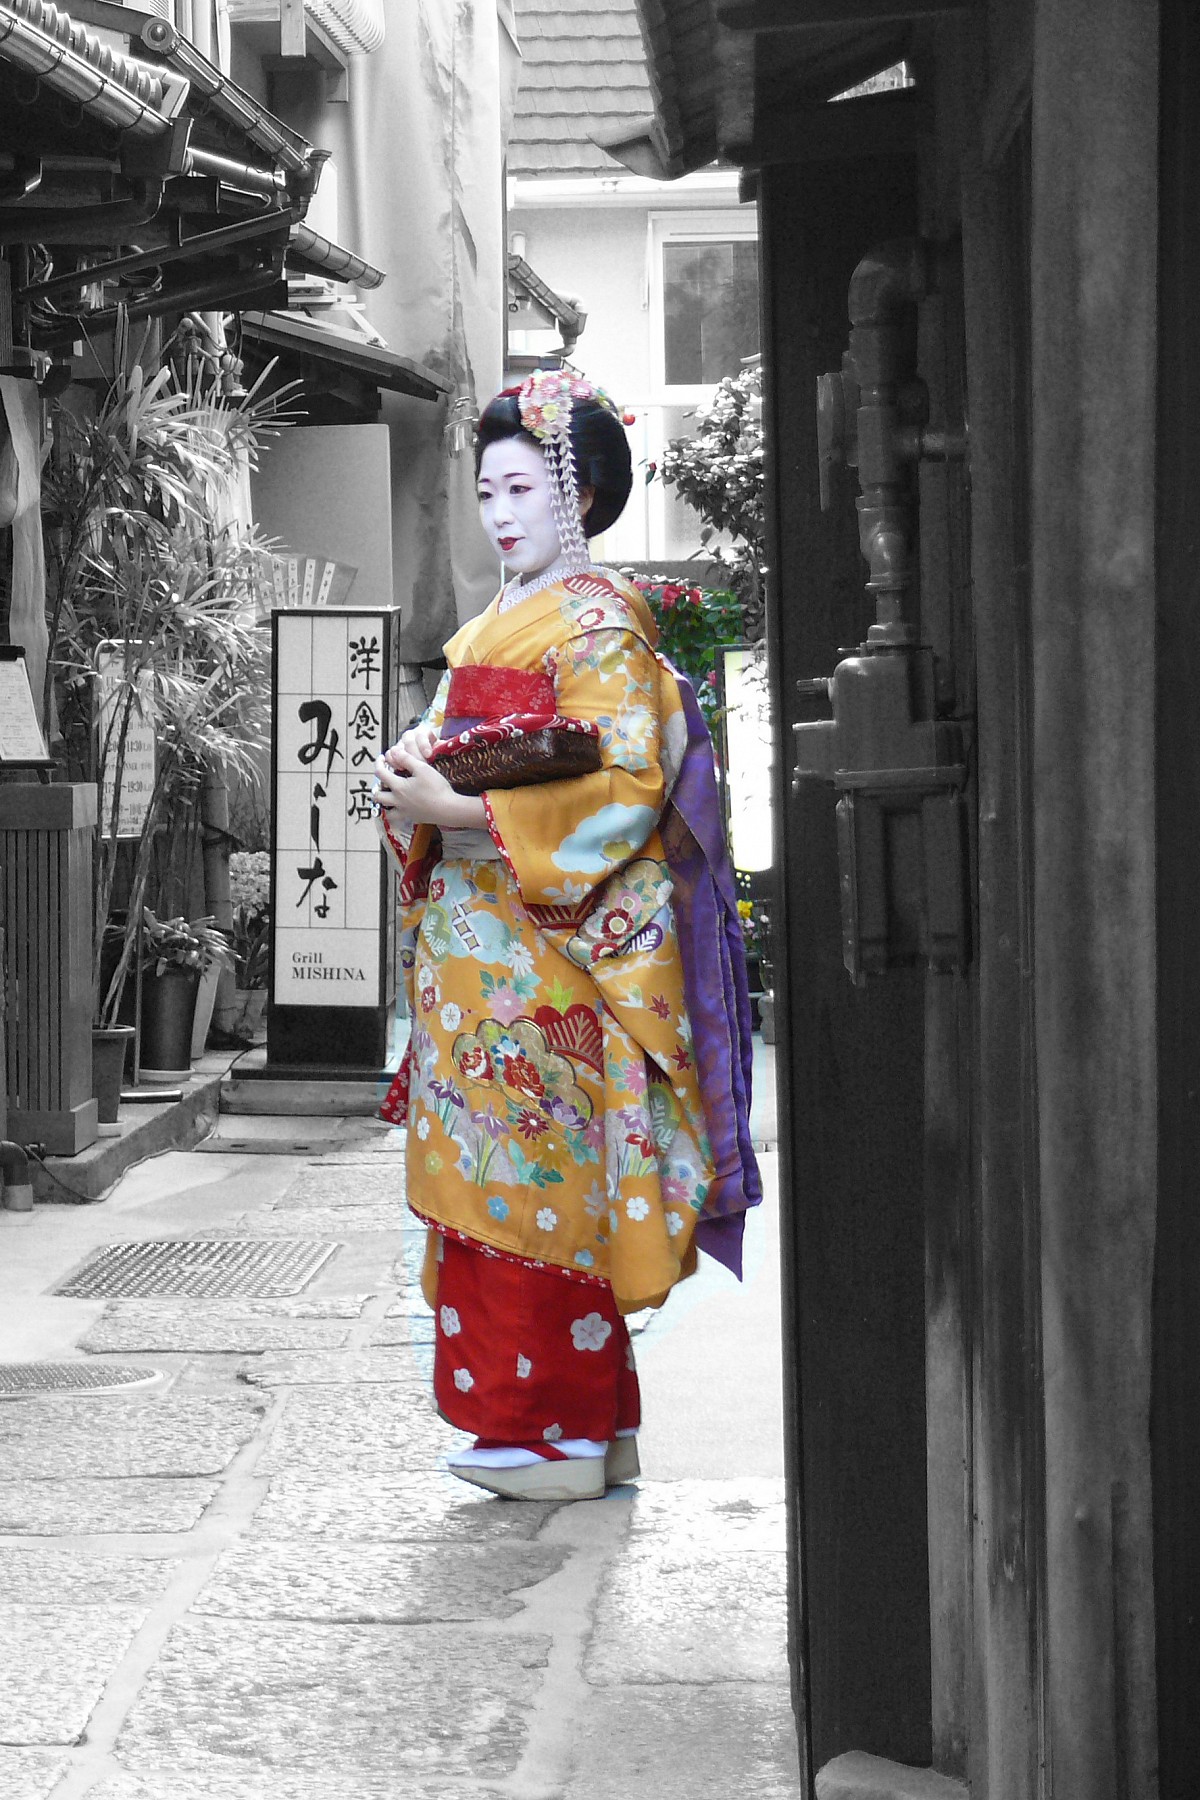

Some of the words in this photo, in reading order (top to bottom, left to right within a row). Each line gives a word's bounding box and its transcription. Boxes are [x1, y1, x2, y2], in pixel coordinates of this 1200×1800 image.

[348, 636, 380, 824] 洋食の店
[292, 952, 323, 964] Grill
[292, 966, 366, 981] MISHINA
